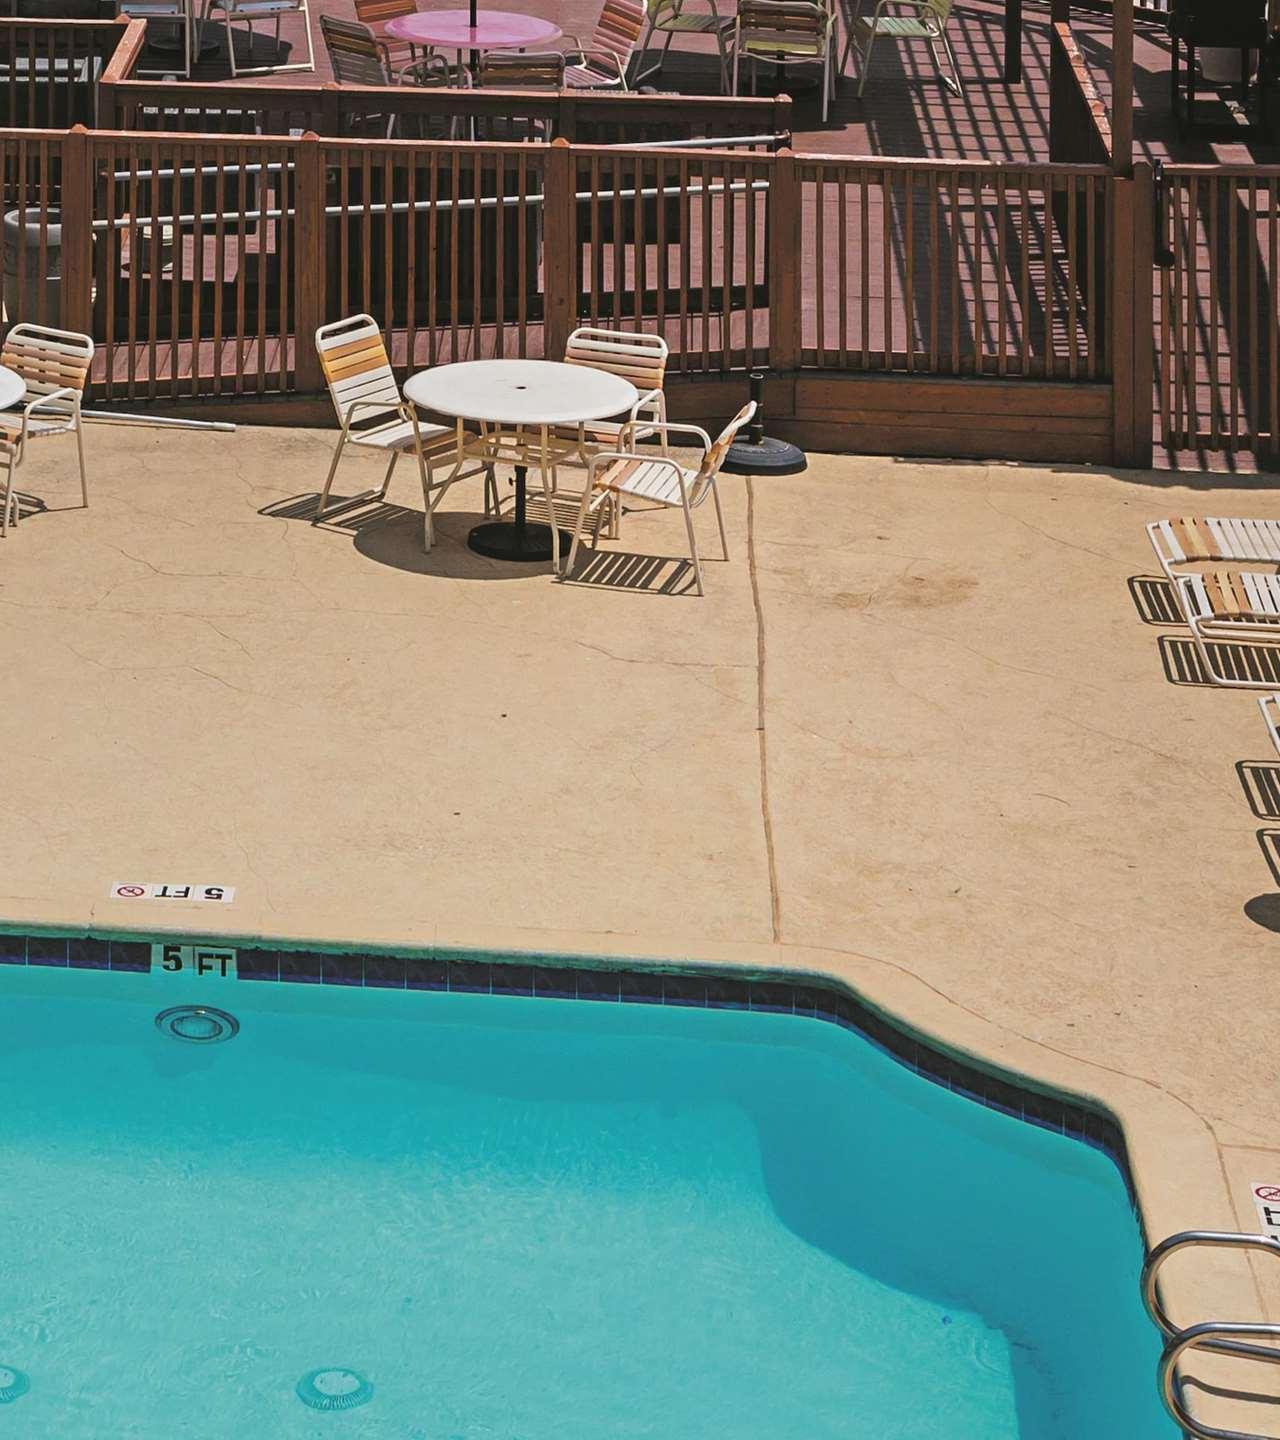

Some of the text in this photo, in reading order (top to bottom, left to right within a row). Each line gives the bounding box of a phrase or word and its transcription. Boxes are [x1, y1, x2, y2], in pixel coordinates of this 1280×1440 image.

[154, 886, 224, 900] 5 FT
[162, 946, 233, 977] 5 FT
